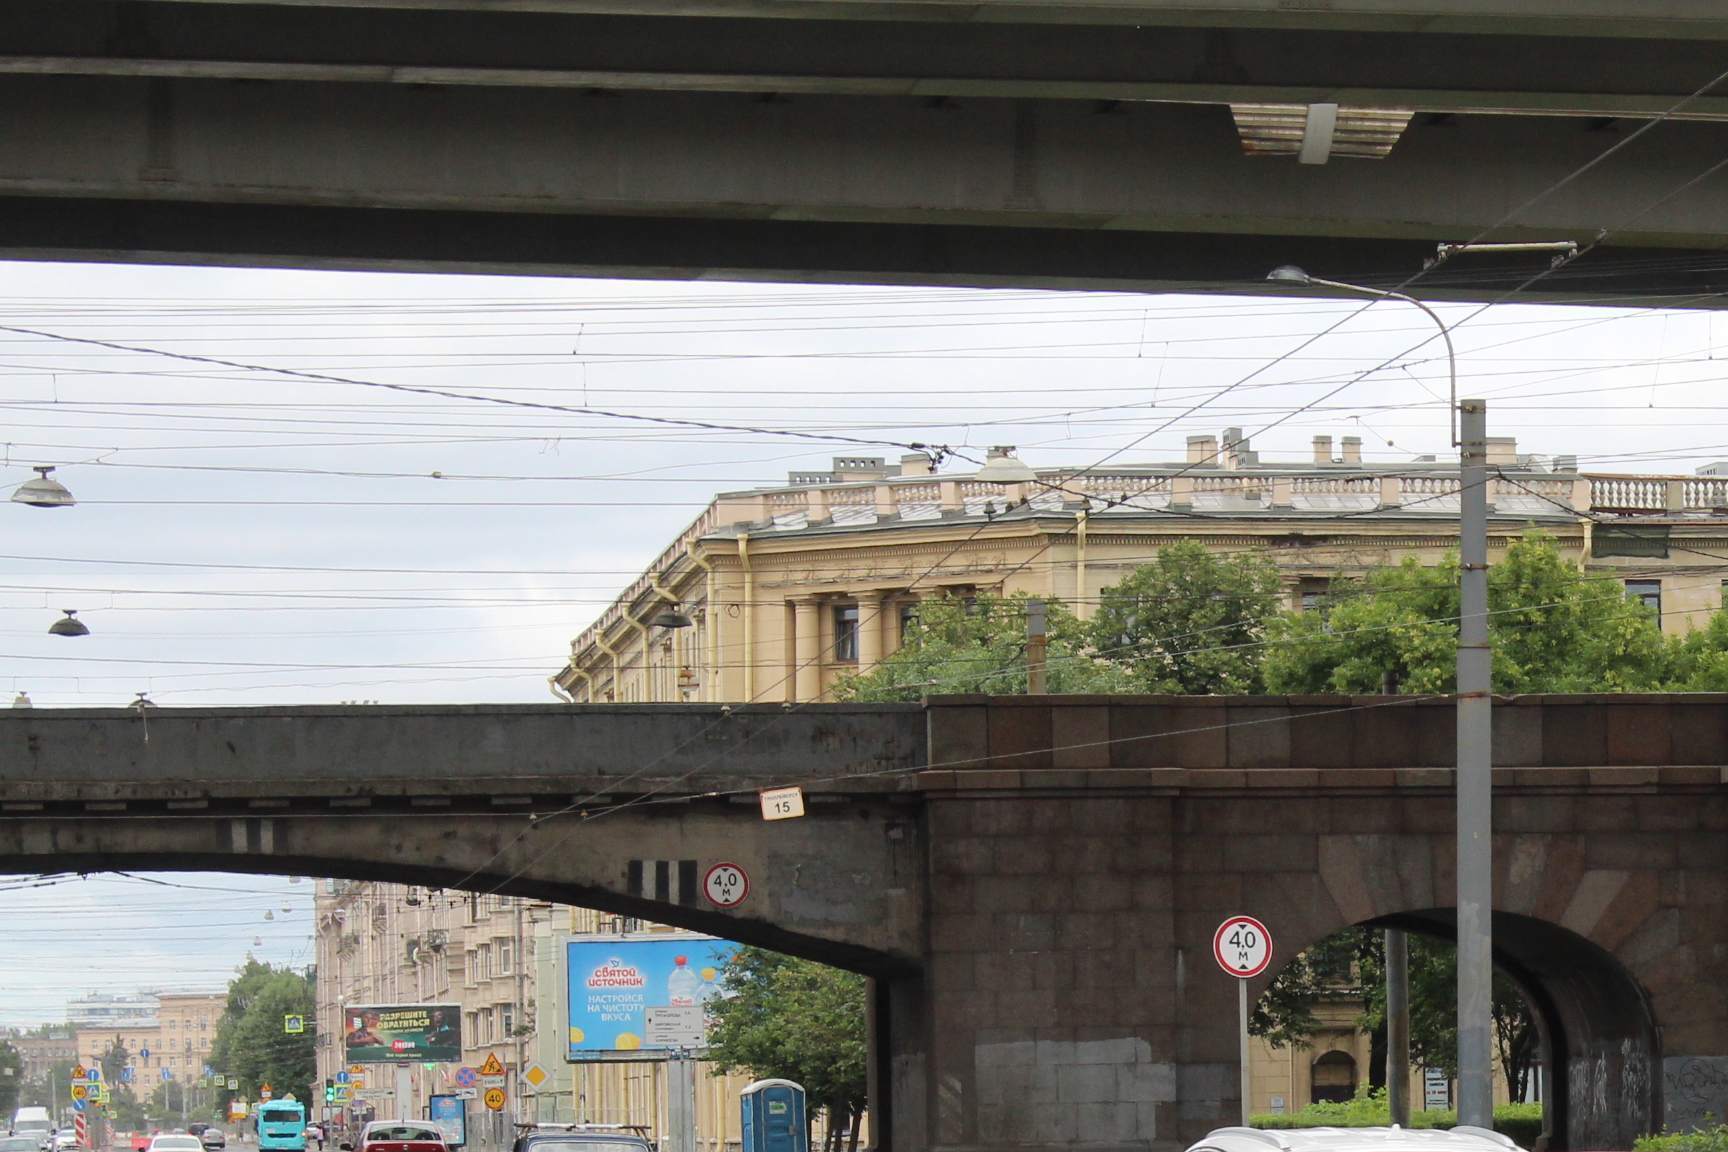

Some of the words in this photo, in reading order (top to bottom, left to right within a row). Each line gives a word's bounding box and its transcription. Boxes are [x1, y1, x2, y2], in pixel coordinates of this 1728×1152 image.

[775, 801, 790, 813] 15
[1238, 951, 1248, 961] М
[588, 994, 644, 1003] НАСТРОЙСЯ
[587, 1004, 600, 1013] НА
[602, 1003, 645, 1012] ЧИСТОТУ
[601, 1013, 631, 1022] ВКУСА
[488, 1095, 501, 1103] 40
